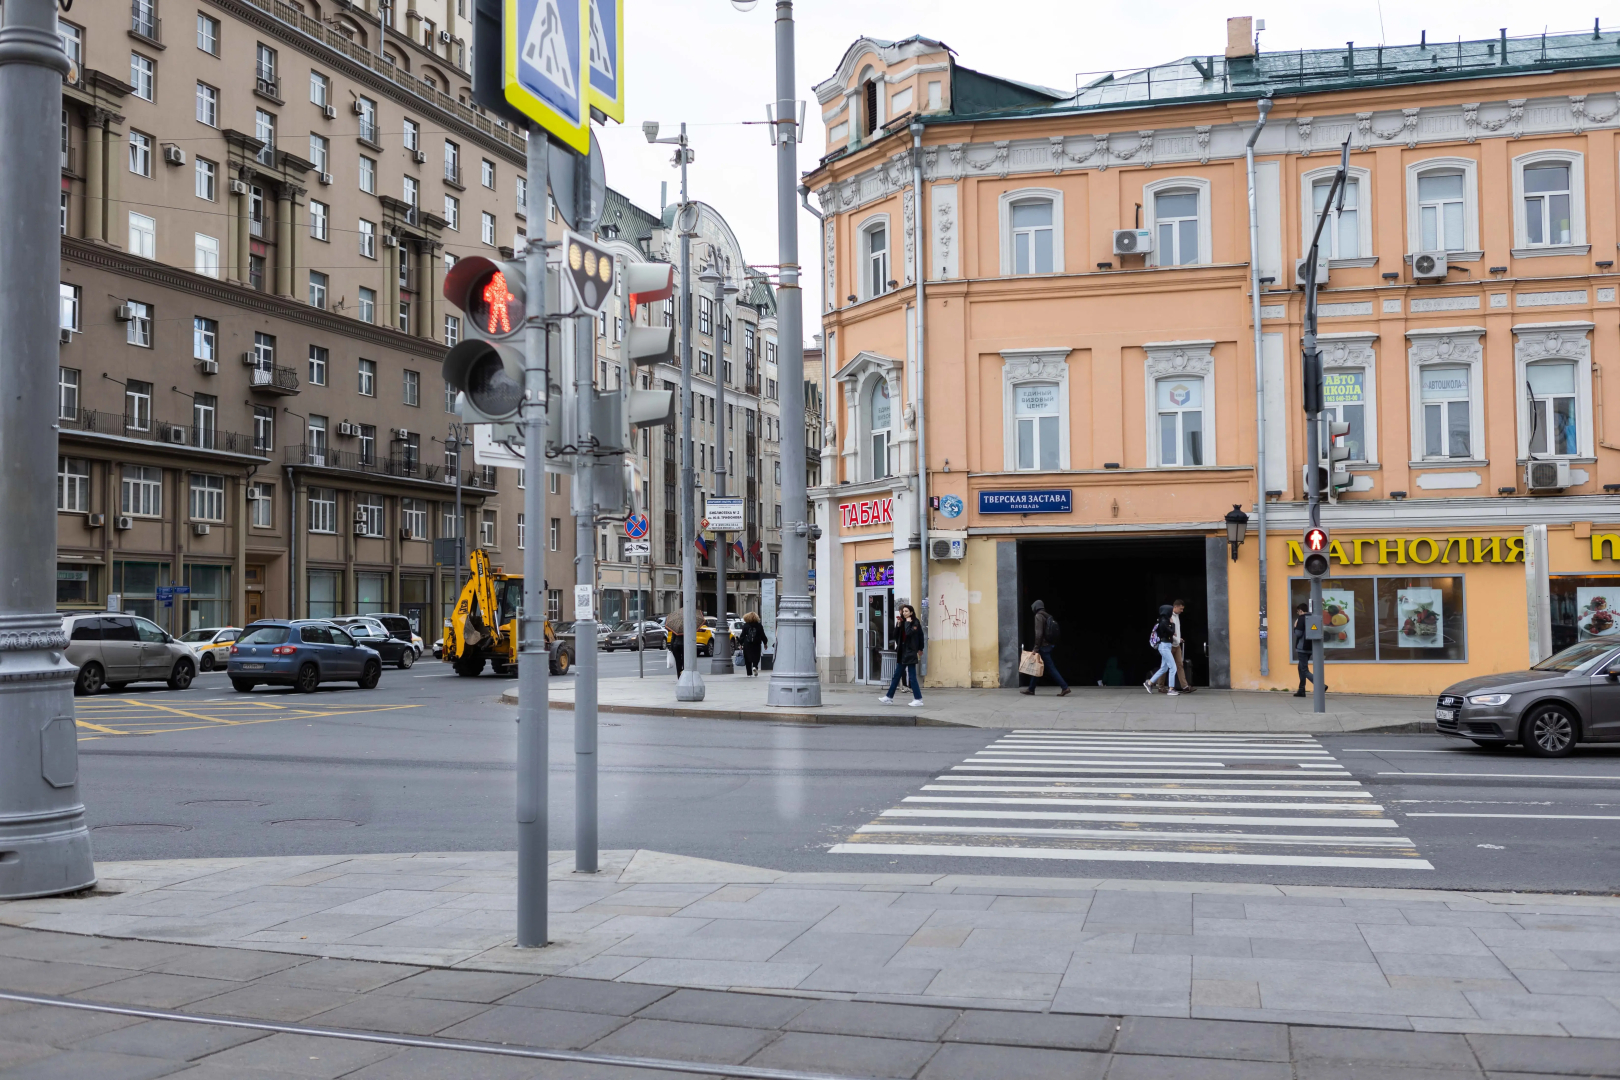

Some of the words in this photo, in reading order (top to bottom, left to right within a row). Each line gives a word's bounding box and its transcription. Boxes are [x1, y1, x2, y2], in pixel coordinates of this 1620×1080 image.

[1325, 375, 1355, 385] АВТО
[1428, 379, 1462, 390] АВТОШКОЛА
[1323, 385, 1361, 395] ШКОЛА
[983, 495, 1027, 503] ТВЕРСКАЯ
[1028, 494, 1066, 503] ЗАСТАВА
[839, 498, 893, 528] ТАБАК
